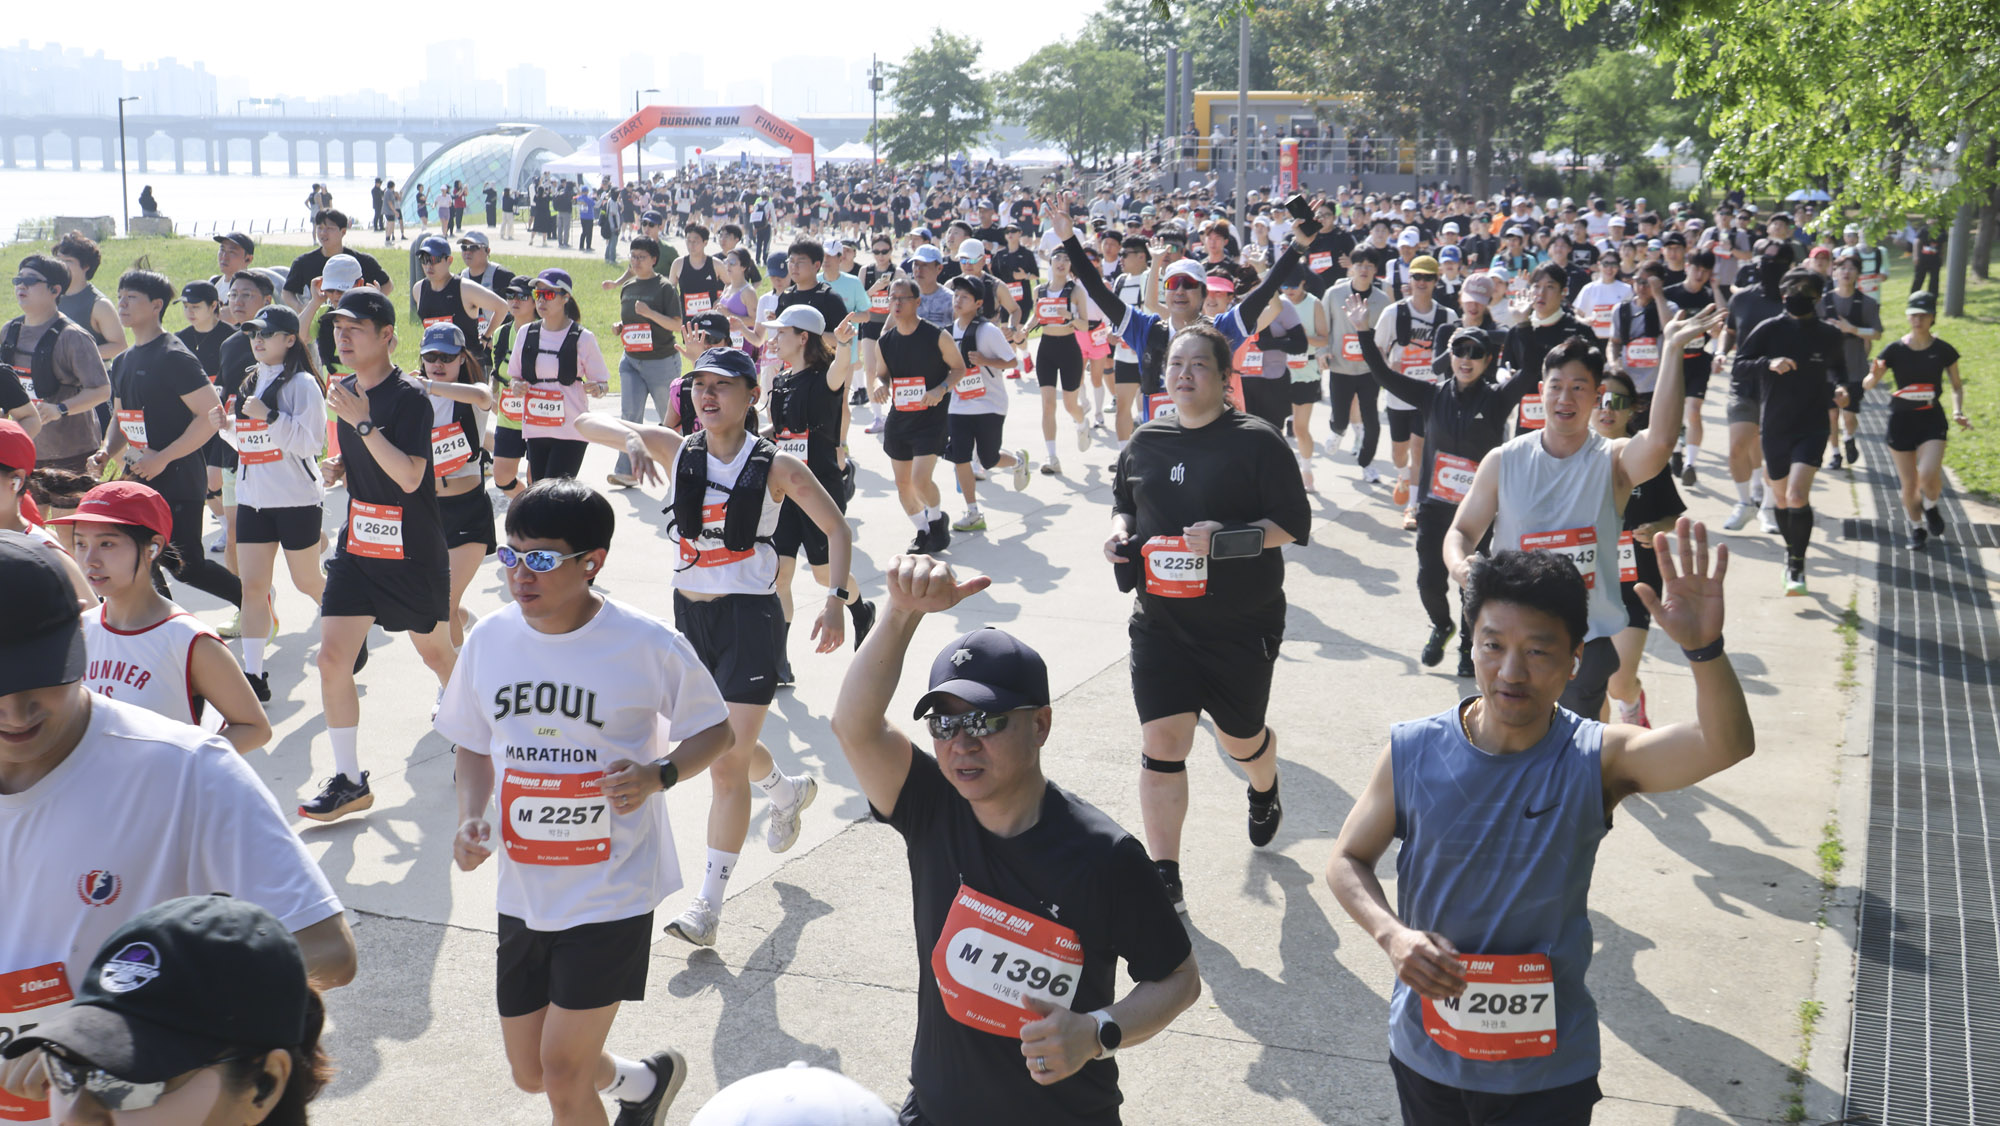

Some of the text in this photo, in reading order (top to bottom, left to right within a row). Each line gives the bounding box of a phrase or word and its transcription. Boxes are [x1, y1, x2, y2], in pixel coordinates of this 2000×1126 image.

[659, 116, 741, 126] BURNING RUN
[611, 116, 644, 143] START
[754, 115, 794, 143] FINISH
[1411, 328, 1433, 340] NIK
[962, 377, 981, 386] 1002
[903, 389, 923, 397] 2301
[538, 403, 561, 411] 4491
[434, 438, 465, 455] 4218
[783, 444, 806, 452] 4440
[1452, 473, 1473, 485] 466
[364, 522, 398, 536] 2620
[1164, 557, 1204, 570] 2258
[494, 680, 605, 730] SEOUL
[537, 727, 557, 736] LIFE
[505, 745, 597, 763] MARATHON
[506, 774, 562, 787] BURNING RUN
[518, 805, 605, 825] M 2257
[959, 895, 1034, 932] BURNING RUN
[1055, 937, 1081, 952] 10km
[959, 943, 1073, 997] M 1396
[1470, 961, 1494, 971] RUN
[1518, 964, 1545, 973] 10km
[19, 978, 59, 993] 10km
[1444, 993, 1549, 1015] M 2087
